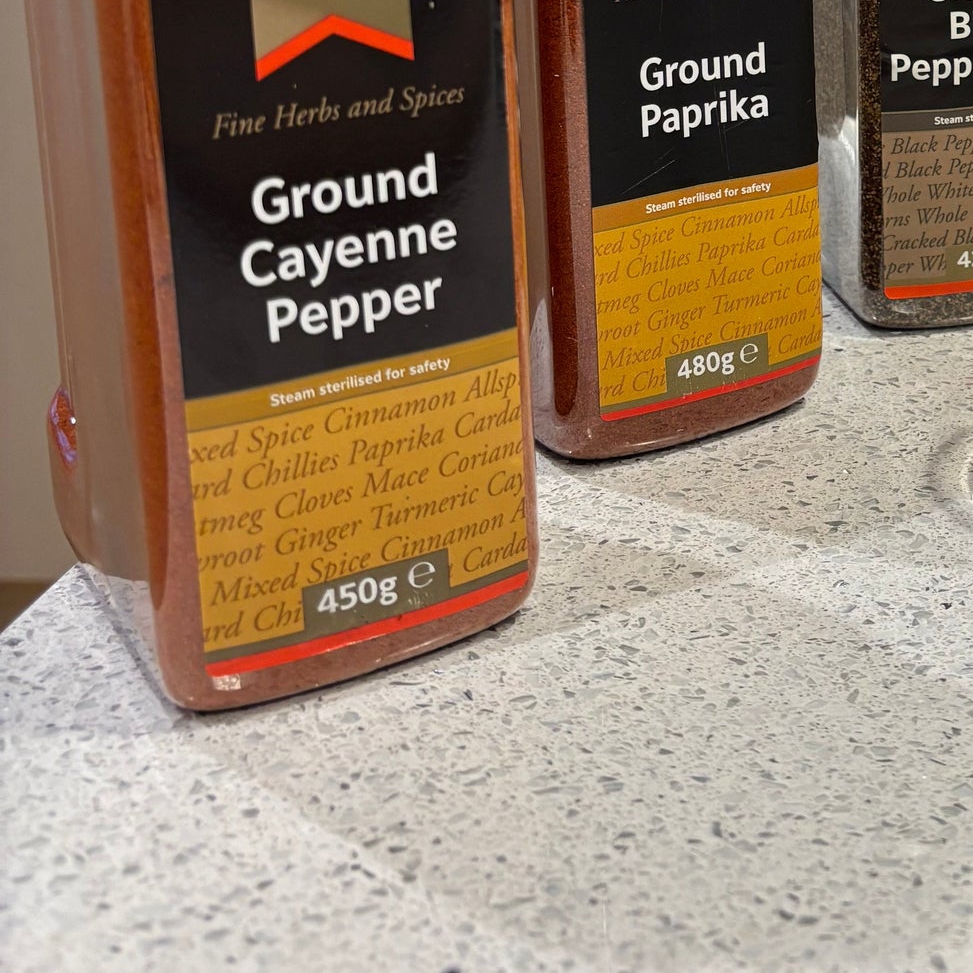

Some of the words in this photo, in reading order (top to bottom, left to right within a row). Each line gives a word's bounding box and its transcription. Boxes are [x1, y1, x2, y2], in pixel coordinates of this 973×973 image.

[640, 42, 766, 91] Ground
[212, 112, 265, 140] Fine
[274, 101, 340, 129] Herbs
[347, 88, 394, 119] and
[400, 86, 465, 117] Spices
[641, 89, 768, 137] Paprika
[934, 115, 963, 125] Steam
[891, 134, 938, 155] Black
[896, 159, 942, 178] Black
[251, 152, 438, 225] Ground
[646, 201, 675, 214] Steam
[678, 190, 721, 206] sterilised
[724, 188, 738, 197] for
[741, 182, 771, 195] safety
[630, 228, 674, 251] Spice
[681, 207, 775, 237] Cinnamon
[917, 205, 968, 224] Whole
[240, 217, 457, 287] Cayenne
[626, 250, 691, 277] Chillies
[697, 235, 765, 265] Paprika
[884, 234, 949, 251] Cracked
[647, 278, 700, 303] Cloves
[705, 266, 754, 289] Mace
[647, 305, 706, 332] Ginger
[712, 283, 790, 316] Turmeric
[265, 276, 442, 343] Pepper
[602, 337, 665, 371] Mixed
[669, 330, 713, 355] Spice
[719, 308, 812, 340] Cinnamon
[270, 387, 315, 408] Steam
[319, 373, 382, 396] sterilised
[386, 368, 405, 381] for
[409, 357, 450, 376] safety
[677, 351, 734, 379] 480g
[247, 422, 314, 457] Spice
[324, 390, 456, 434] Cinnamon
[464, 372, 521, 401] Allsp
[243, 451, 339, 489] Chillies
[349, 426, 443, 465] Paprika
[275, 486, 352, 519] Cloves
[361, 465, 428, 498] Mace
[275, 520, 362, 555] Ginger
[371, 486, 479, 530] Turmeric
[211, 571, 299, 606] Mixed
[307, 552, 369, 583] Spice
[381, 514, 504, 562] Cinnamon
[317, 573, 398, 614] 450g
